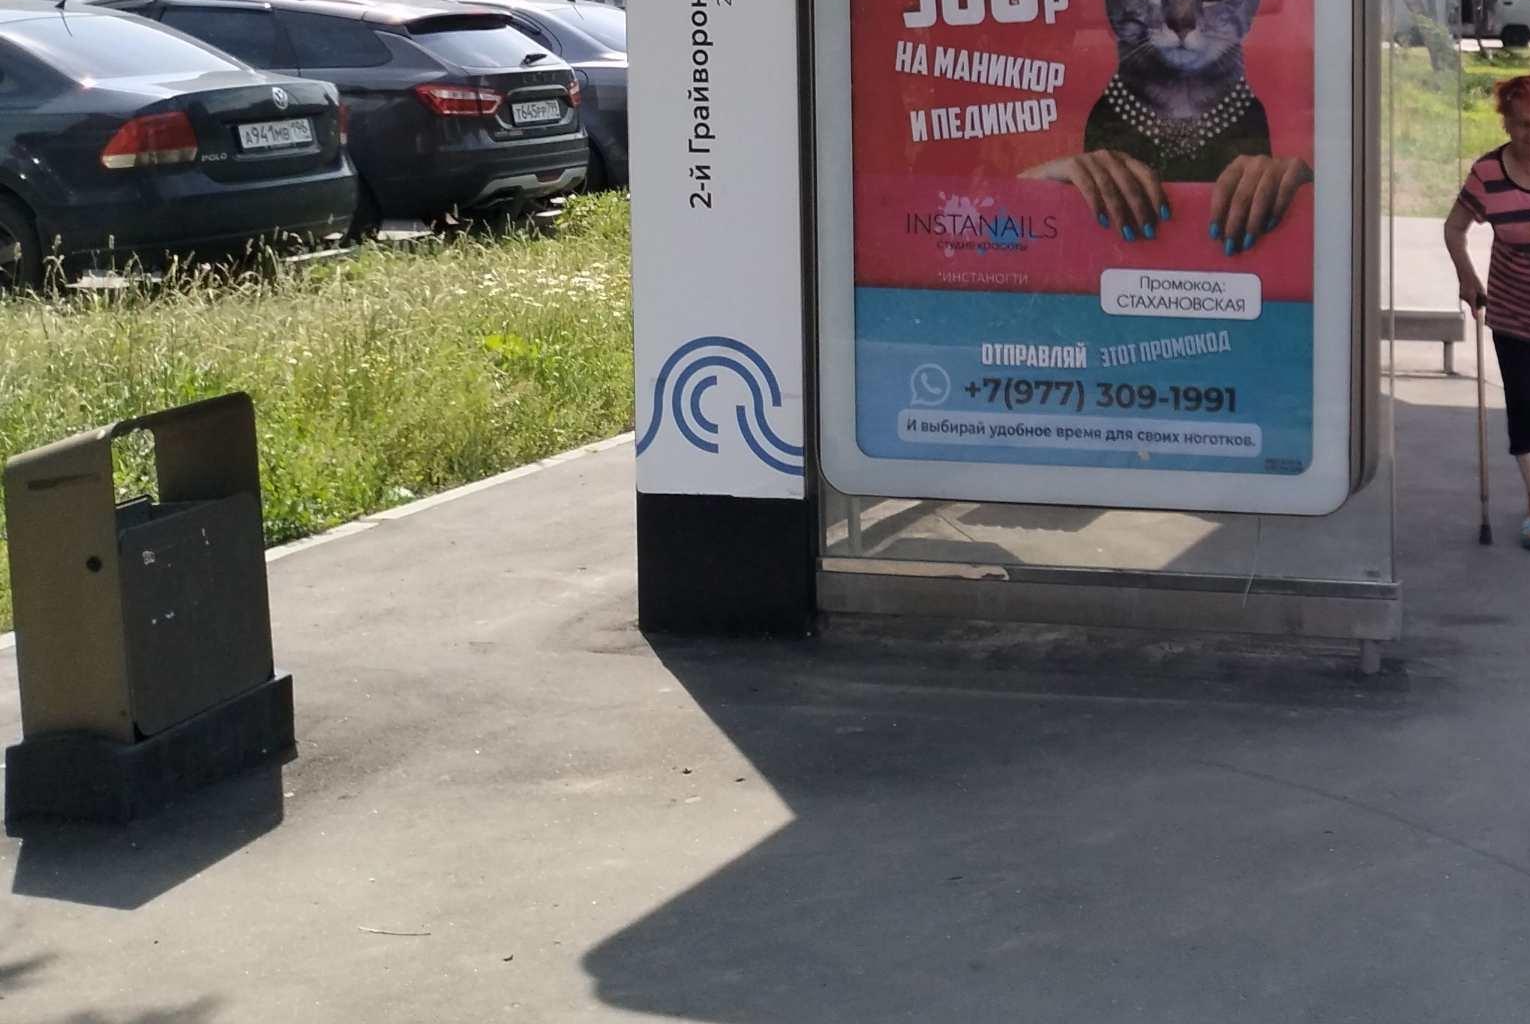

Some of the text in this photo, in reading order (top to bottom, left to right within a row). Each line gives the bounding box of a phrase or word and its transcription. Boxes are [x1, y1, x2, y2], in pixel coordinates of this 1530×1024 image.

[895, 40, 1066, 94] НА МАНИКЮР
[910, 98, 1058, 142] И ПЕДИКЮР
[689, 164, 712, 209] 2-й
[905, 212, 1059, 240] INSTANAILS
[1139, 275, 1226, 295] Промокод:
[1116, 294, 1246, 313] СТАХАНОВСКАЯ
[981, 330, 1231, 369] ОТПРАВЛЯЙ ЭТОТ ПРОМОКОД
[964, 377, 1237, 413] +7(977) 309-1991
[907, 418, 1256, 449] И выбирай удобное время для своих ноготков.
